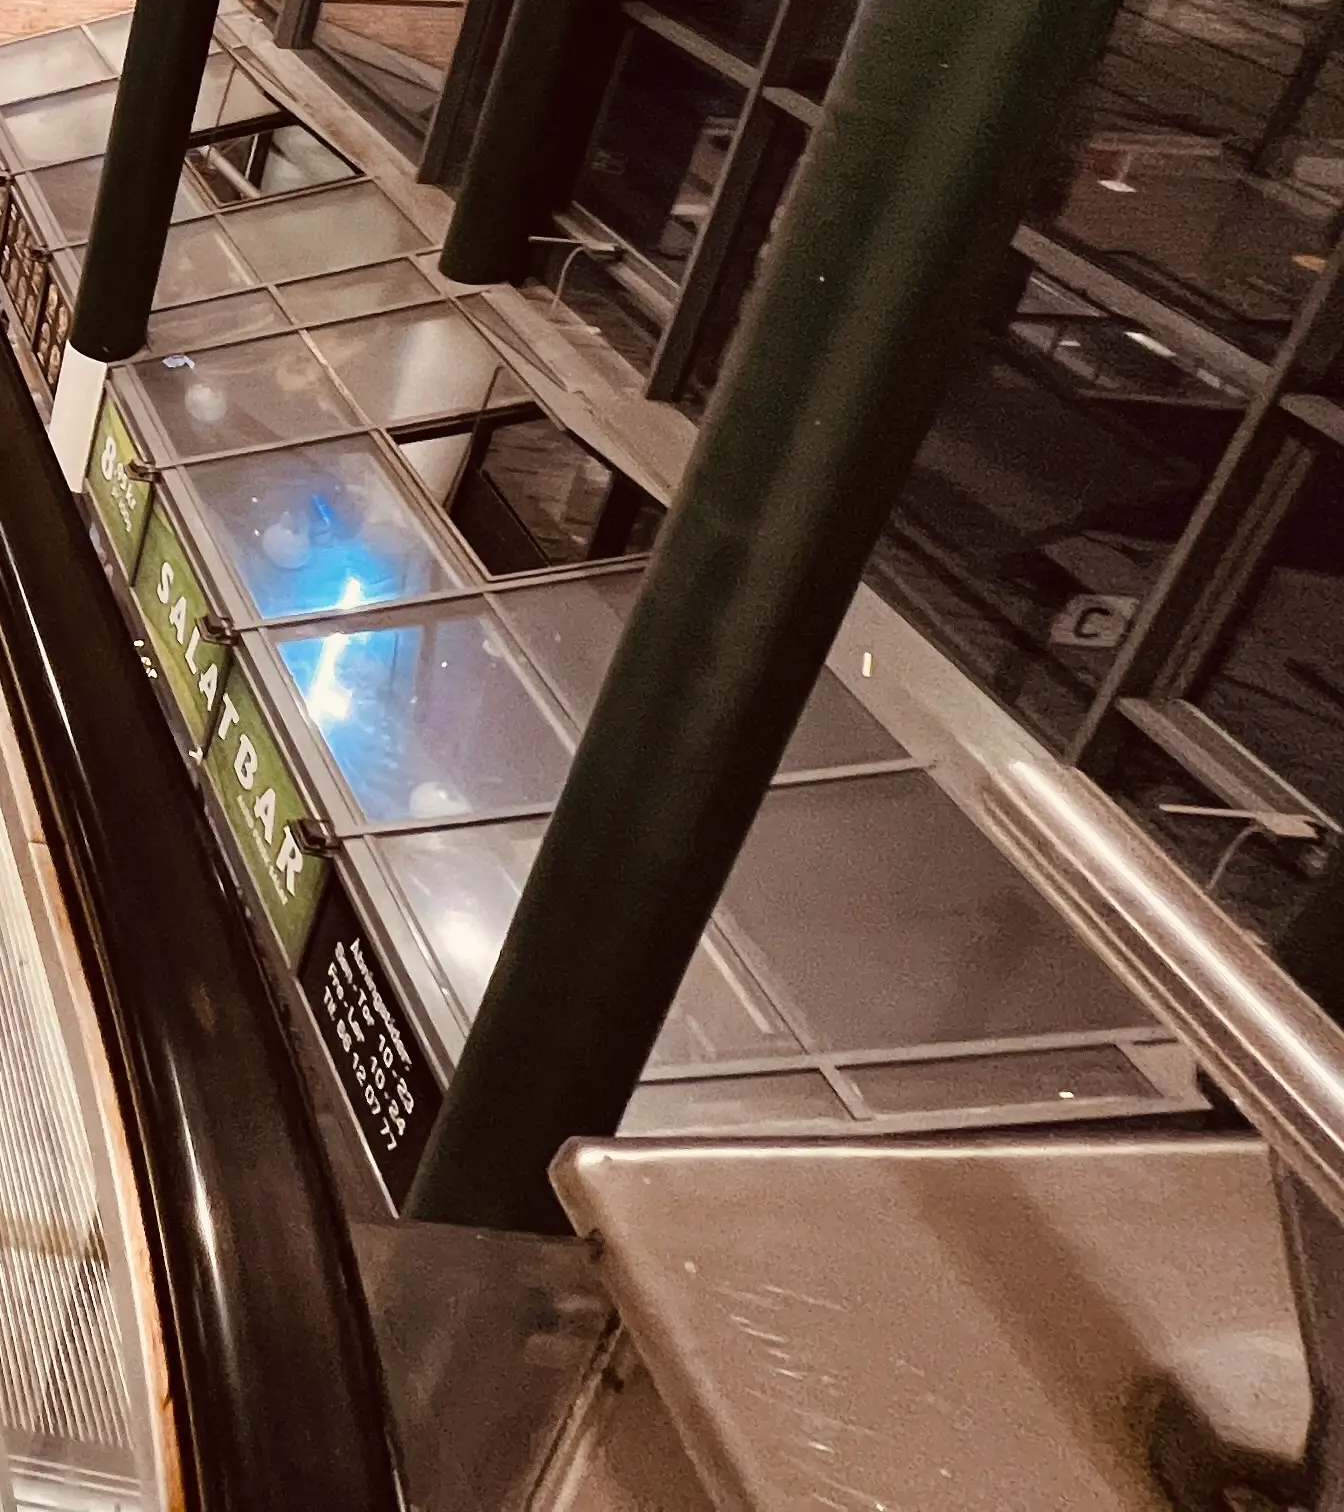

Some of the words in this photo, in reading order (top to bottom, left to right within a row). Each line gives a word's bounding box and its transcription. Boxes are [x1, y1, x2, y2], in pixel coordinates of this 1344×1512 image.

[156, 561, 304, 897] SALATBAR
[353, 1052, 366, 1088] 12
[365, 1084, 381, 1116] 07
[380, 1117, 398, 1151] 77
